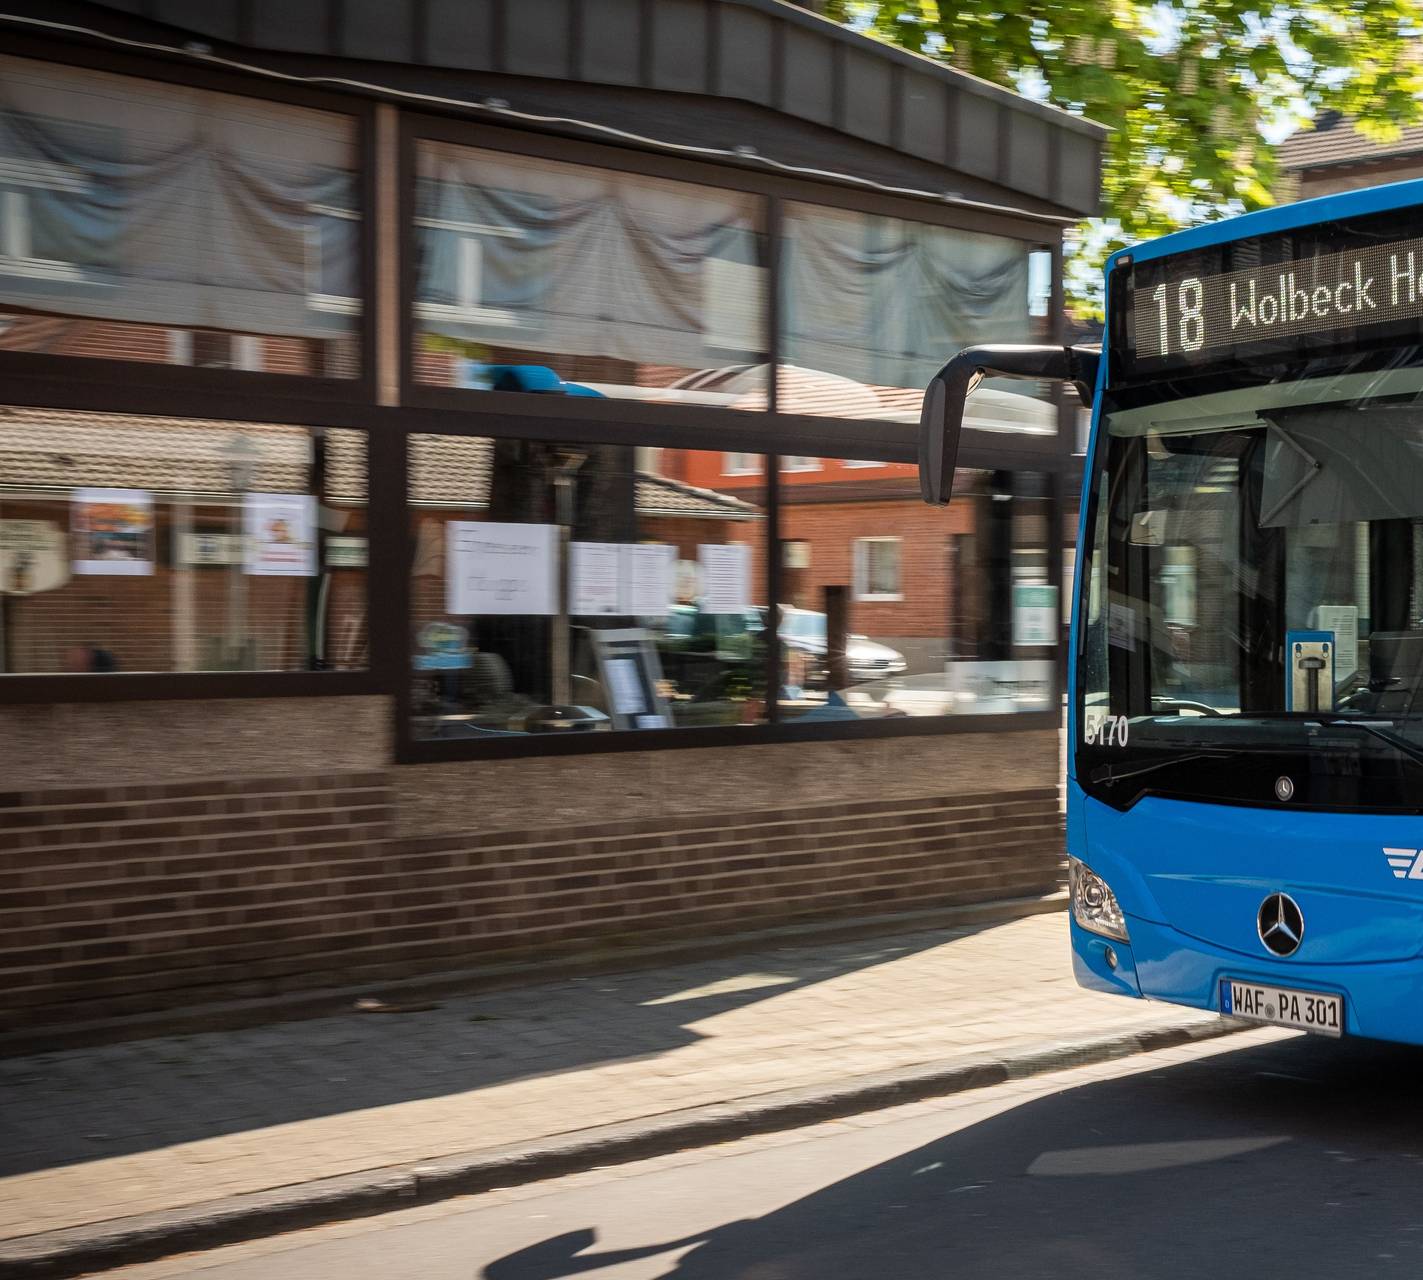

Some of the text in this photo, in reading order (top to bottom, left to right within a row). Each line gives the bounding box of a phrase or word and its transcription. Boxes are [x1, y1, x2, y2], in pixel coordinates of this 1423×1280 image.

[1153, 277, 1204, 356] 18
[1230, 261, 1377, 330] Wolbeck
[1086, 714, 1129, 748] 5170
[1233, 986, 1265, 1015] WAF
[1279, 993, 1301, 1022] PA
[1305, 998, 1339, 1028] 301
